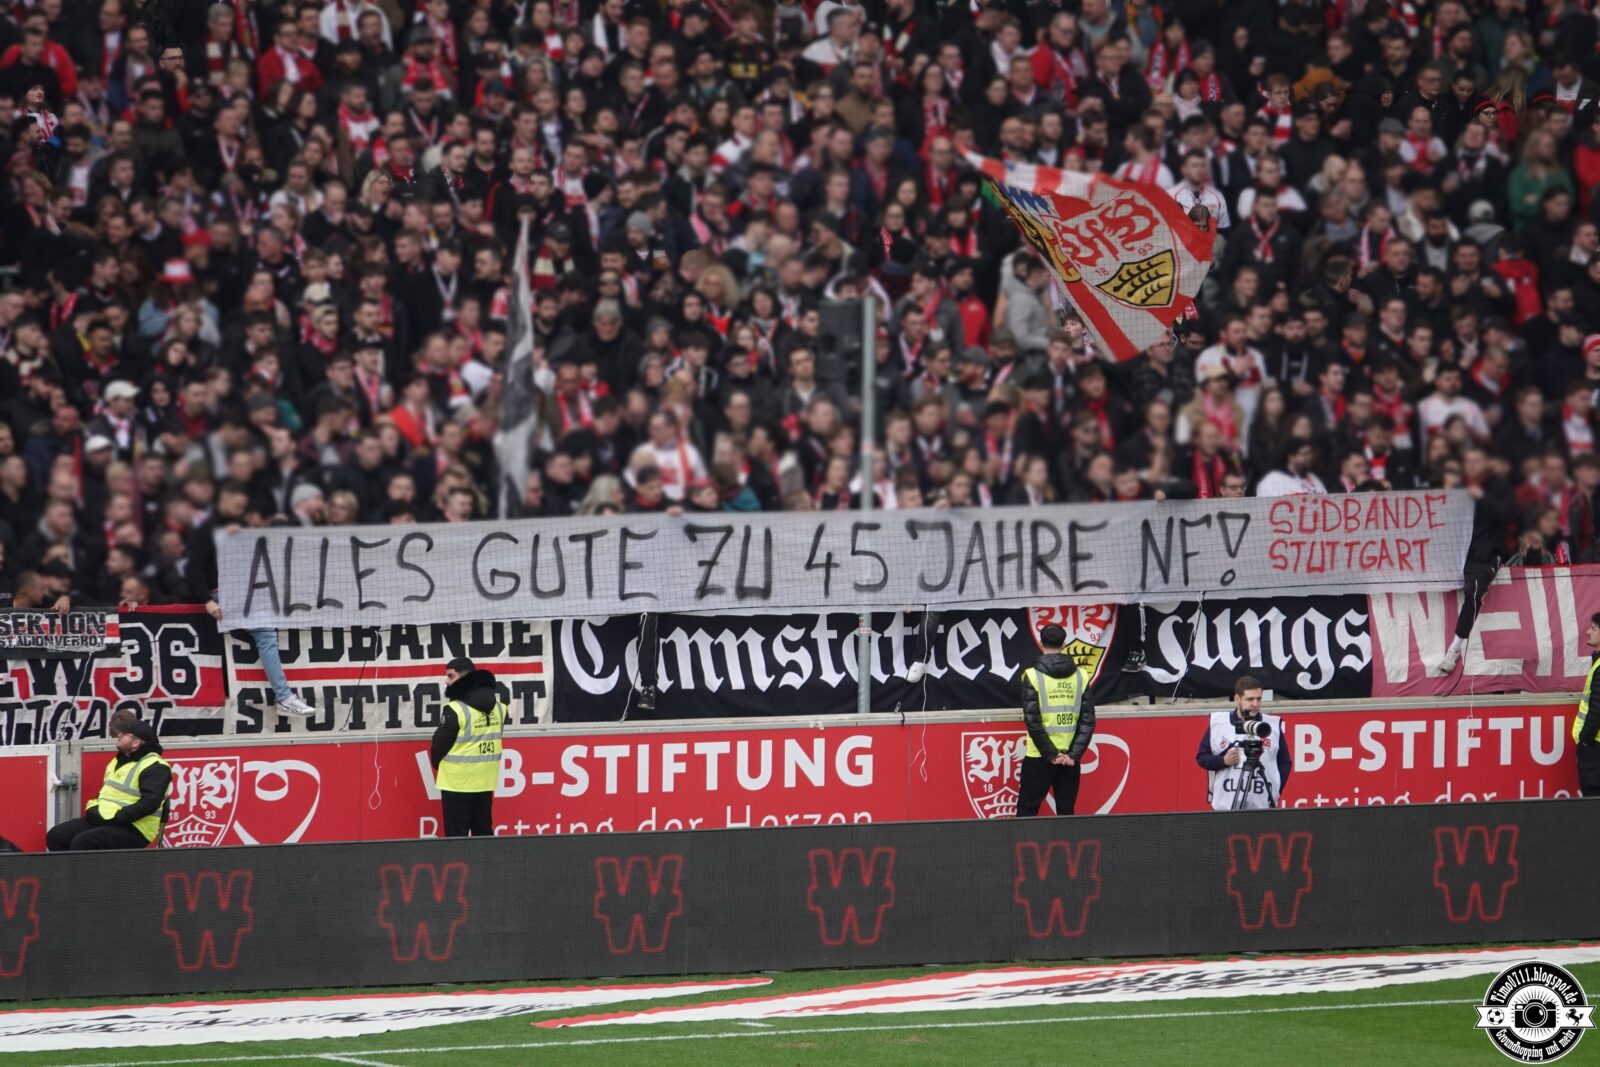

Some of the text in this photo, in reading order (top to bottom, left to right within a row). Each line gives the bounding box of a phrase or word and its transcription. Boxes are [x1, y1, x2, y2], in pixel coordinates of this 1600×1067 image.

[1268, 494, 1447, 535] SÜDBANDE
[243, 532, 435, 617] ALLES
[472, 527, 658, 601] GUTE
[684, 524, 772, 601] ZU
[805, 521, 889, 599] 45
[906, 519, 1108, 598] JAHRE
[1268, 537, 1431, 575] STUTTGART
[0, 612, 106, 635] SEKTION
[113, 624, 200, 698] 36
[1056, 713, 1074, 726] 0899
[479, 741, 495, 754] 1243
[415, 735, 873, 800] VB-STIFTUNG
[983, 783, 993, 793] 18
[204, 810, 217, 820] 93
